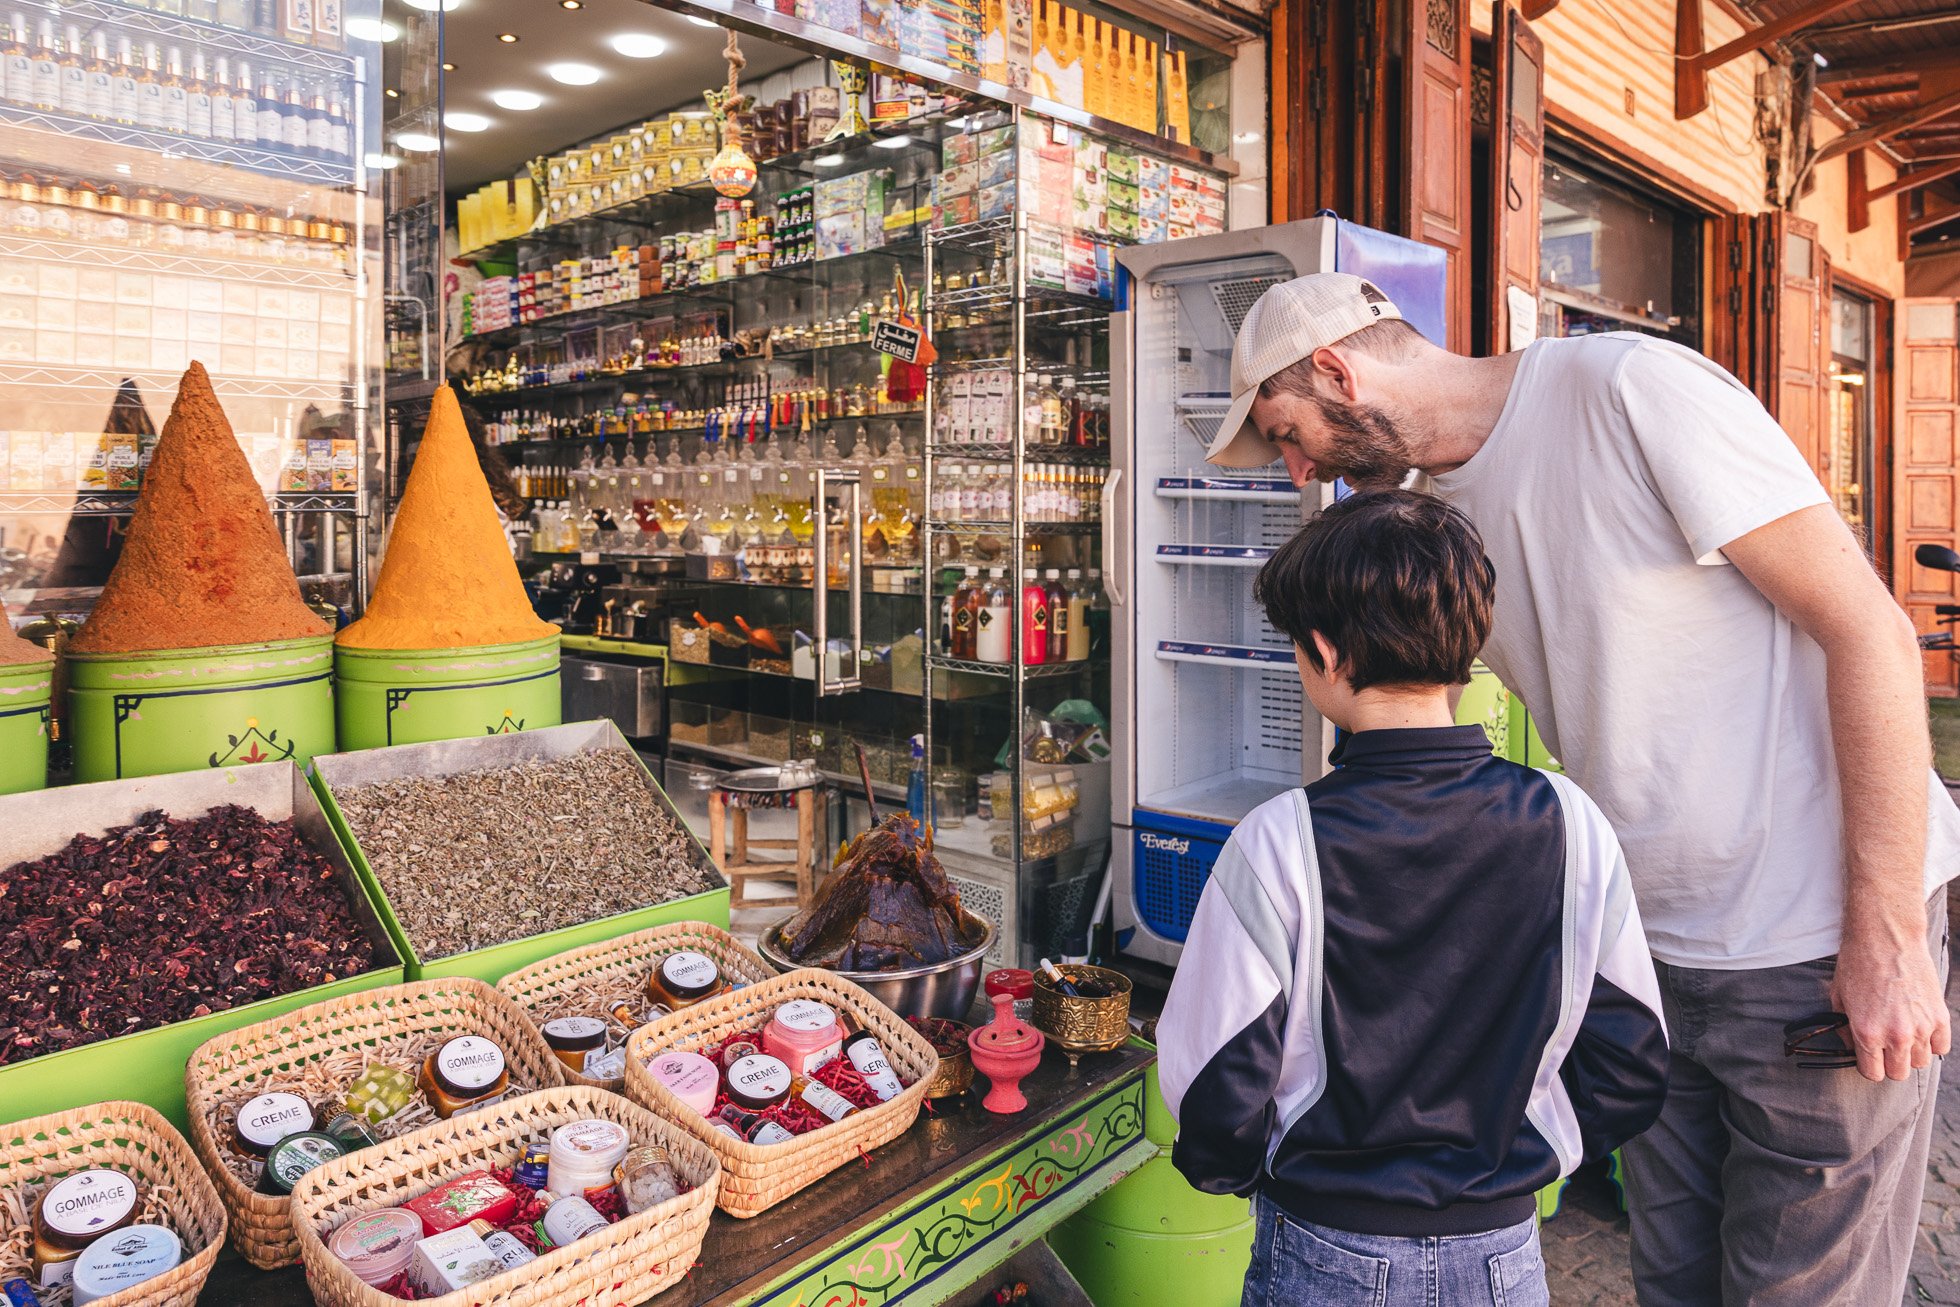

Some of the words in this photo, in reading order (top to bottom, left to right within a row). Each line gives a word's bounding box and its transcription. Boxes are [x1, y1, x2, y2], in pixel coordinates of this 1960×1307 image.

[877, 324, 915, 344] مغلق
[876, 338, 913, 360] FERME
[1140, 833, 1190, 854] Everest
[672, 961, 709, 978] GOMMAGE
[785, 1007, 826, 1022] GOMMAGE
[447, 1052, 496, 1069] GOMMAGE
[740, 1065, 779, 1085] CREME
[251, 1107, 301, 1128] CREME
[566, 1127, 603, 1138] GOMMAGE
[55, 1186, 125, 1213] GOMMAGE
[66, 1208, 89, 1217] BASE
[106, 1197, 127, 1206] NILA
